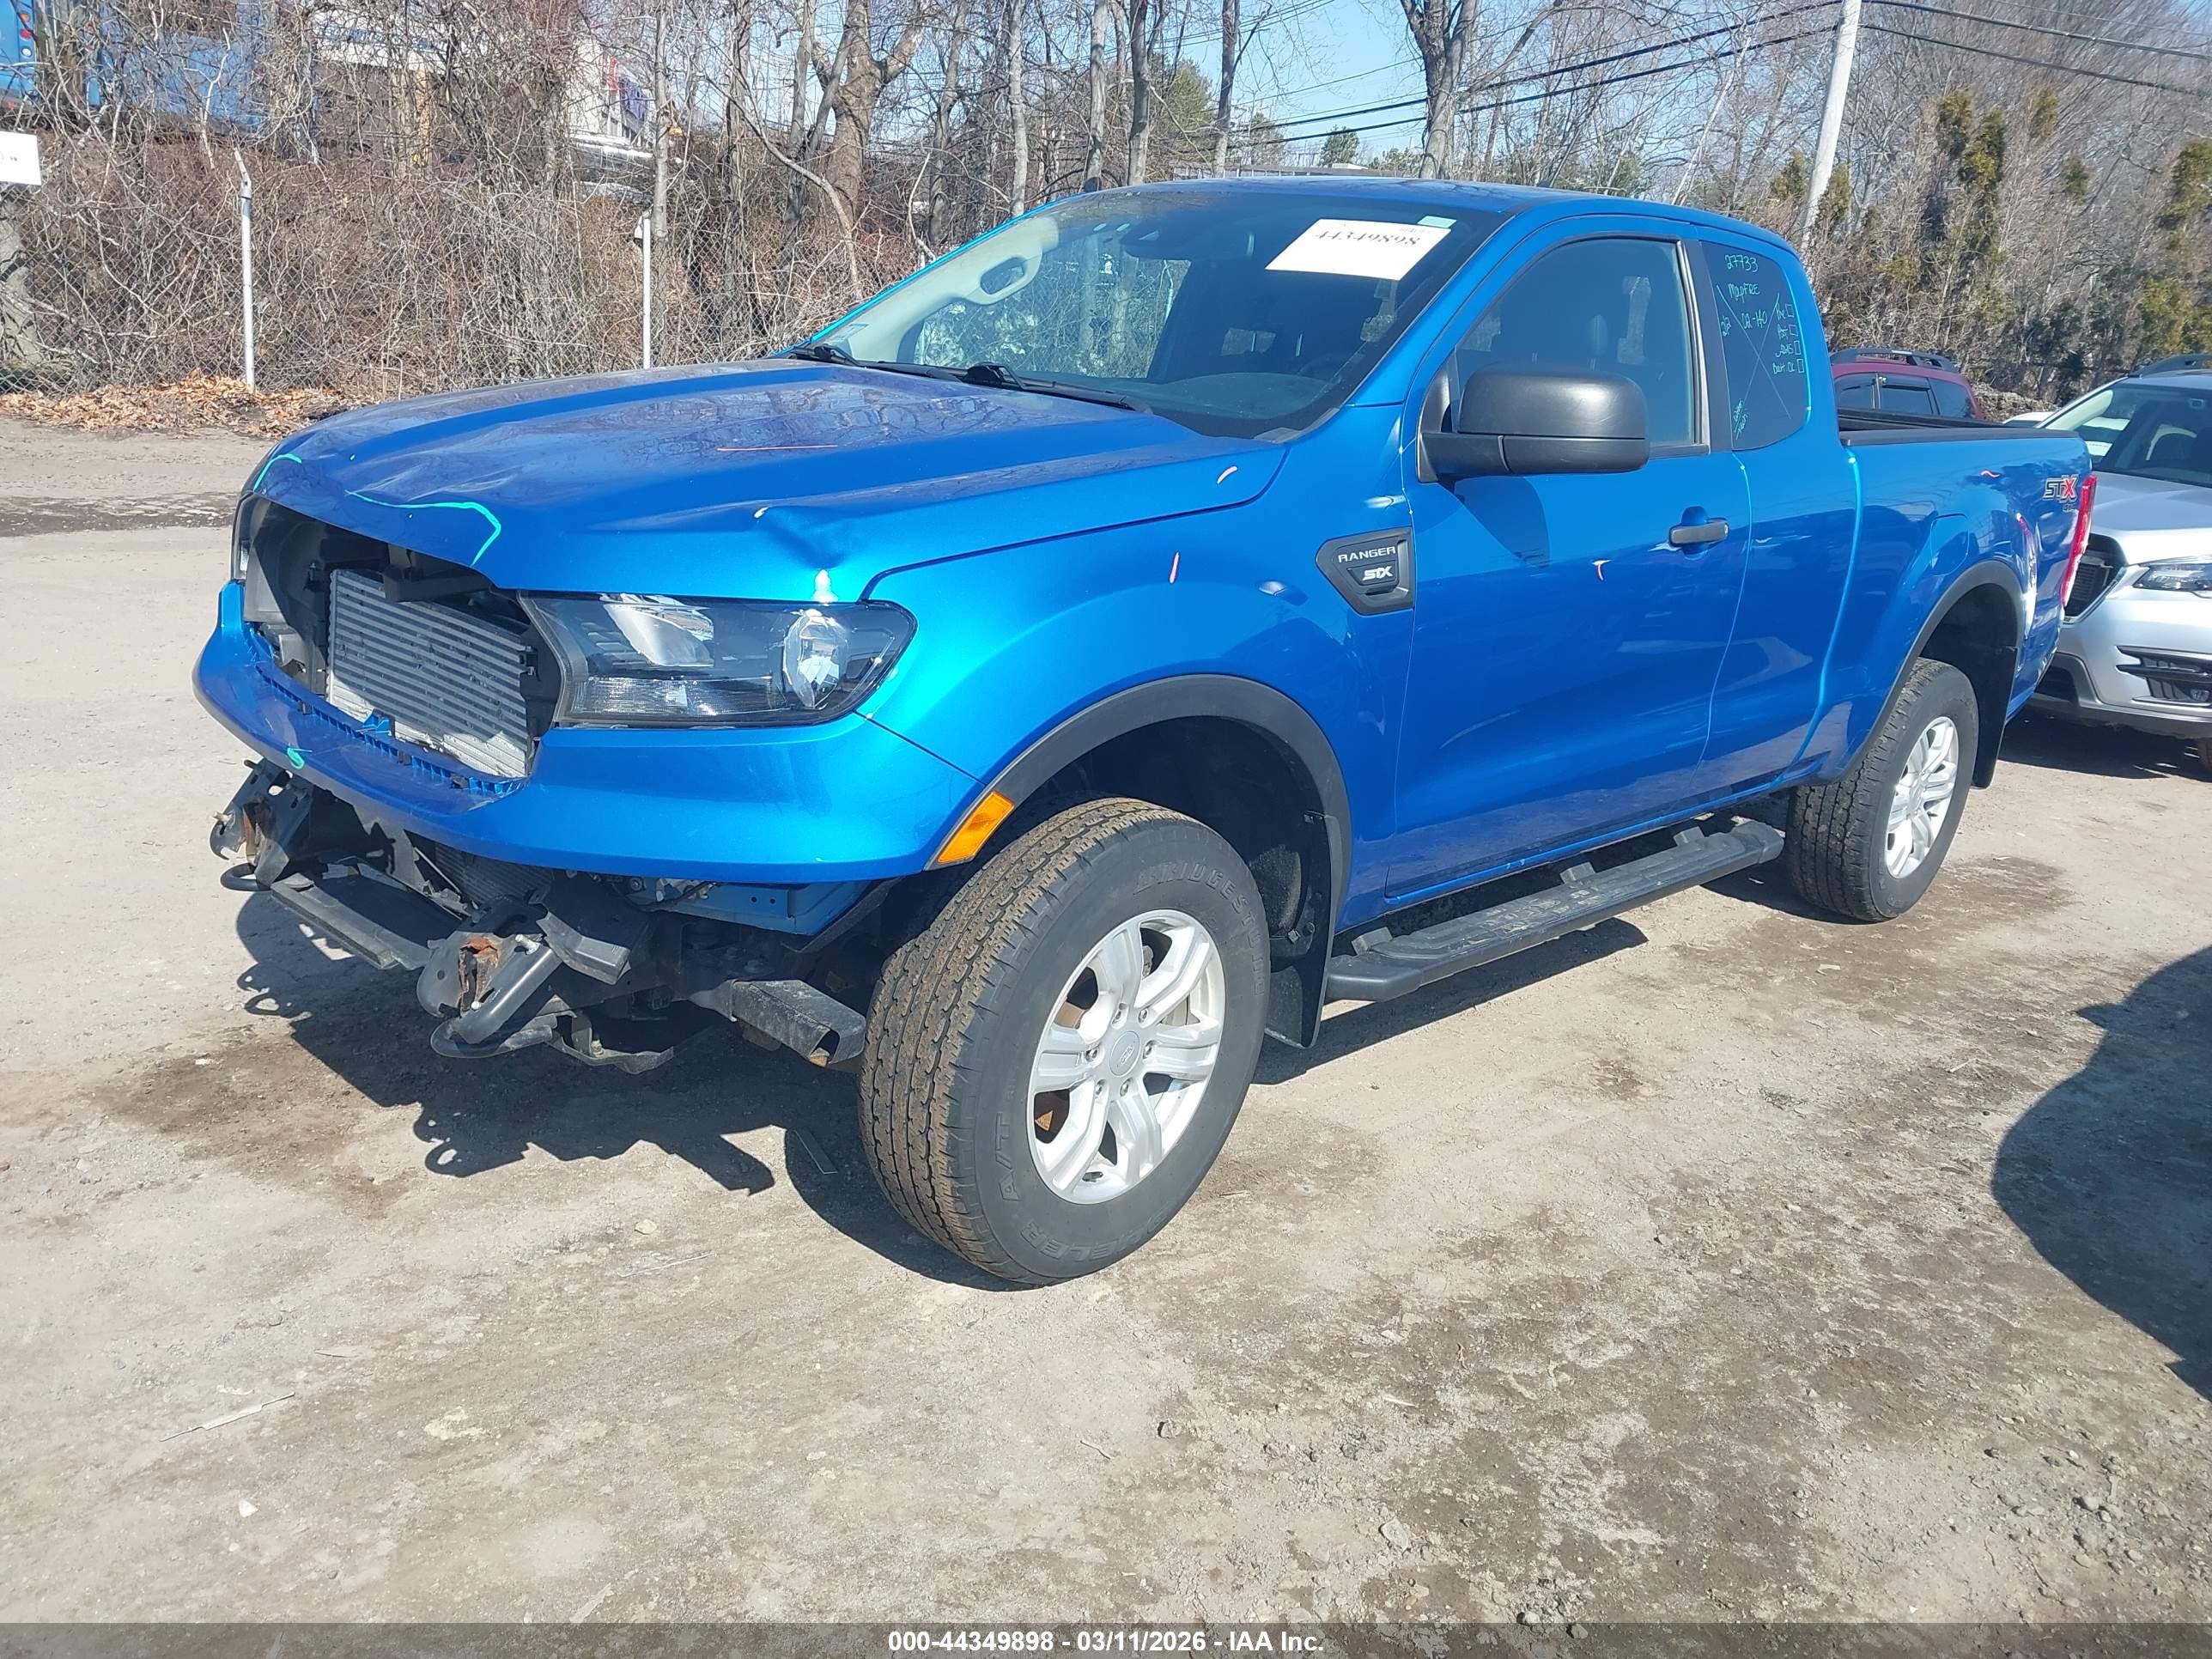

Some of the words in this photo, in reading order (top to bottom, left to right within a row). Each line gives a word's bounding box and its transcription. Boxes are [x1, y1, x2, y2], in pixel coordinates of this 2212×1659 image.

[1724, 254, 1759, 272] 27733
[2043, 474, 2079, 503] STX
[1338, 546, 1396, 562] RANGER
[1362, 566, 1393, 580] STX
